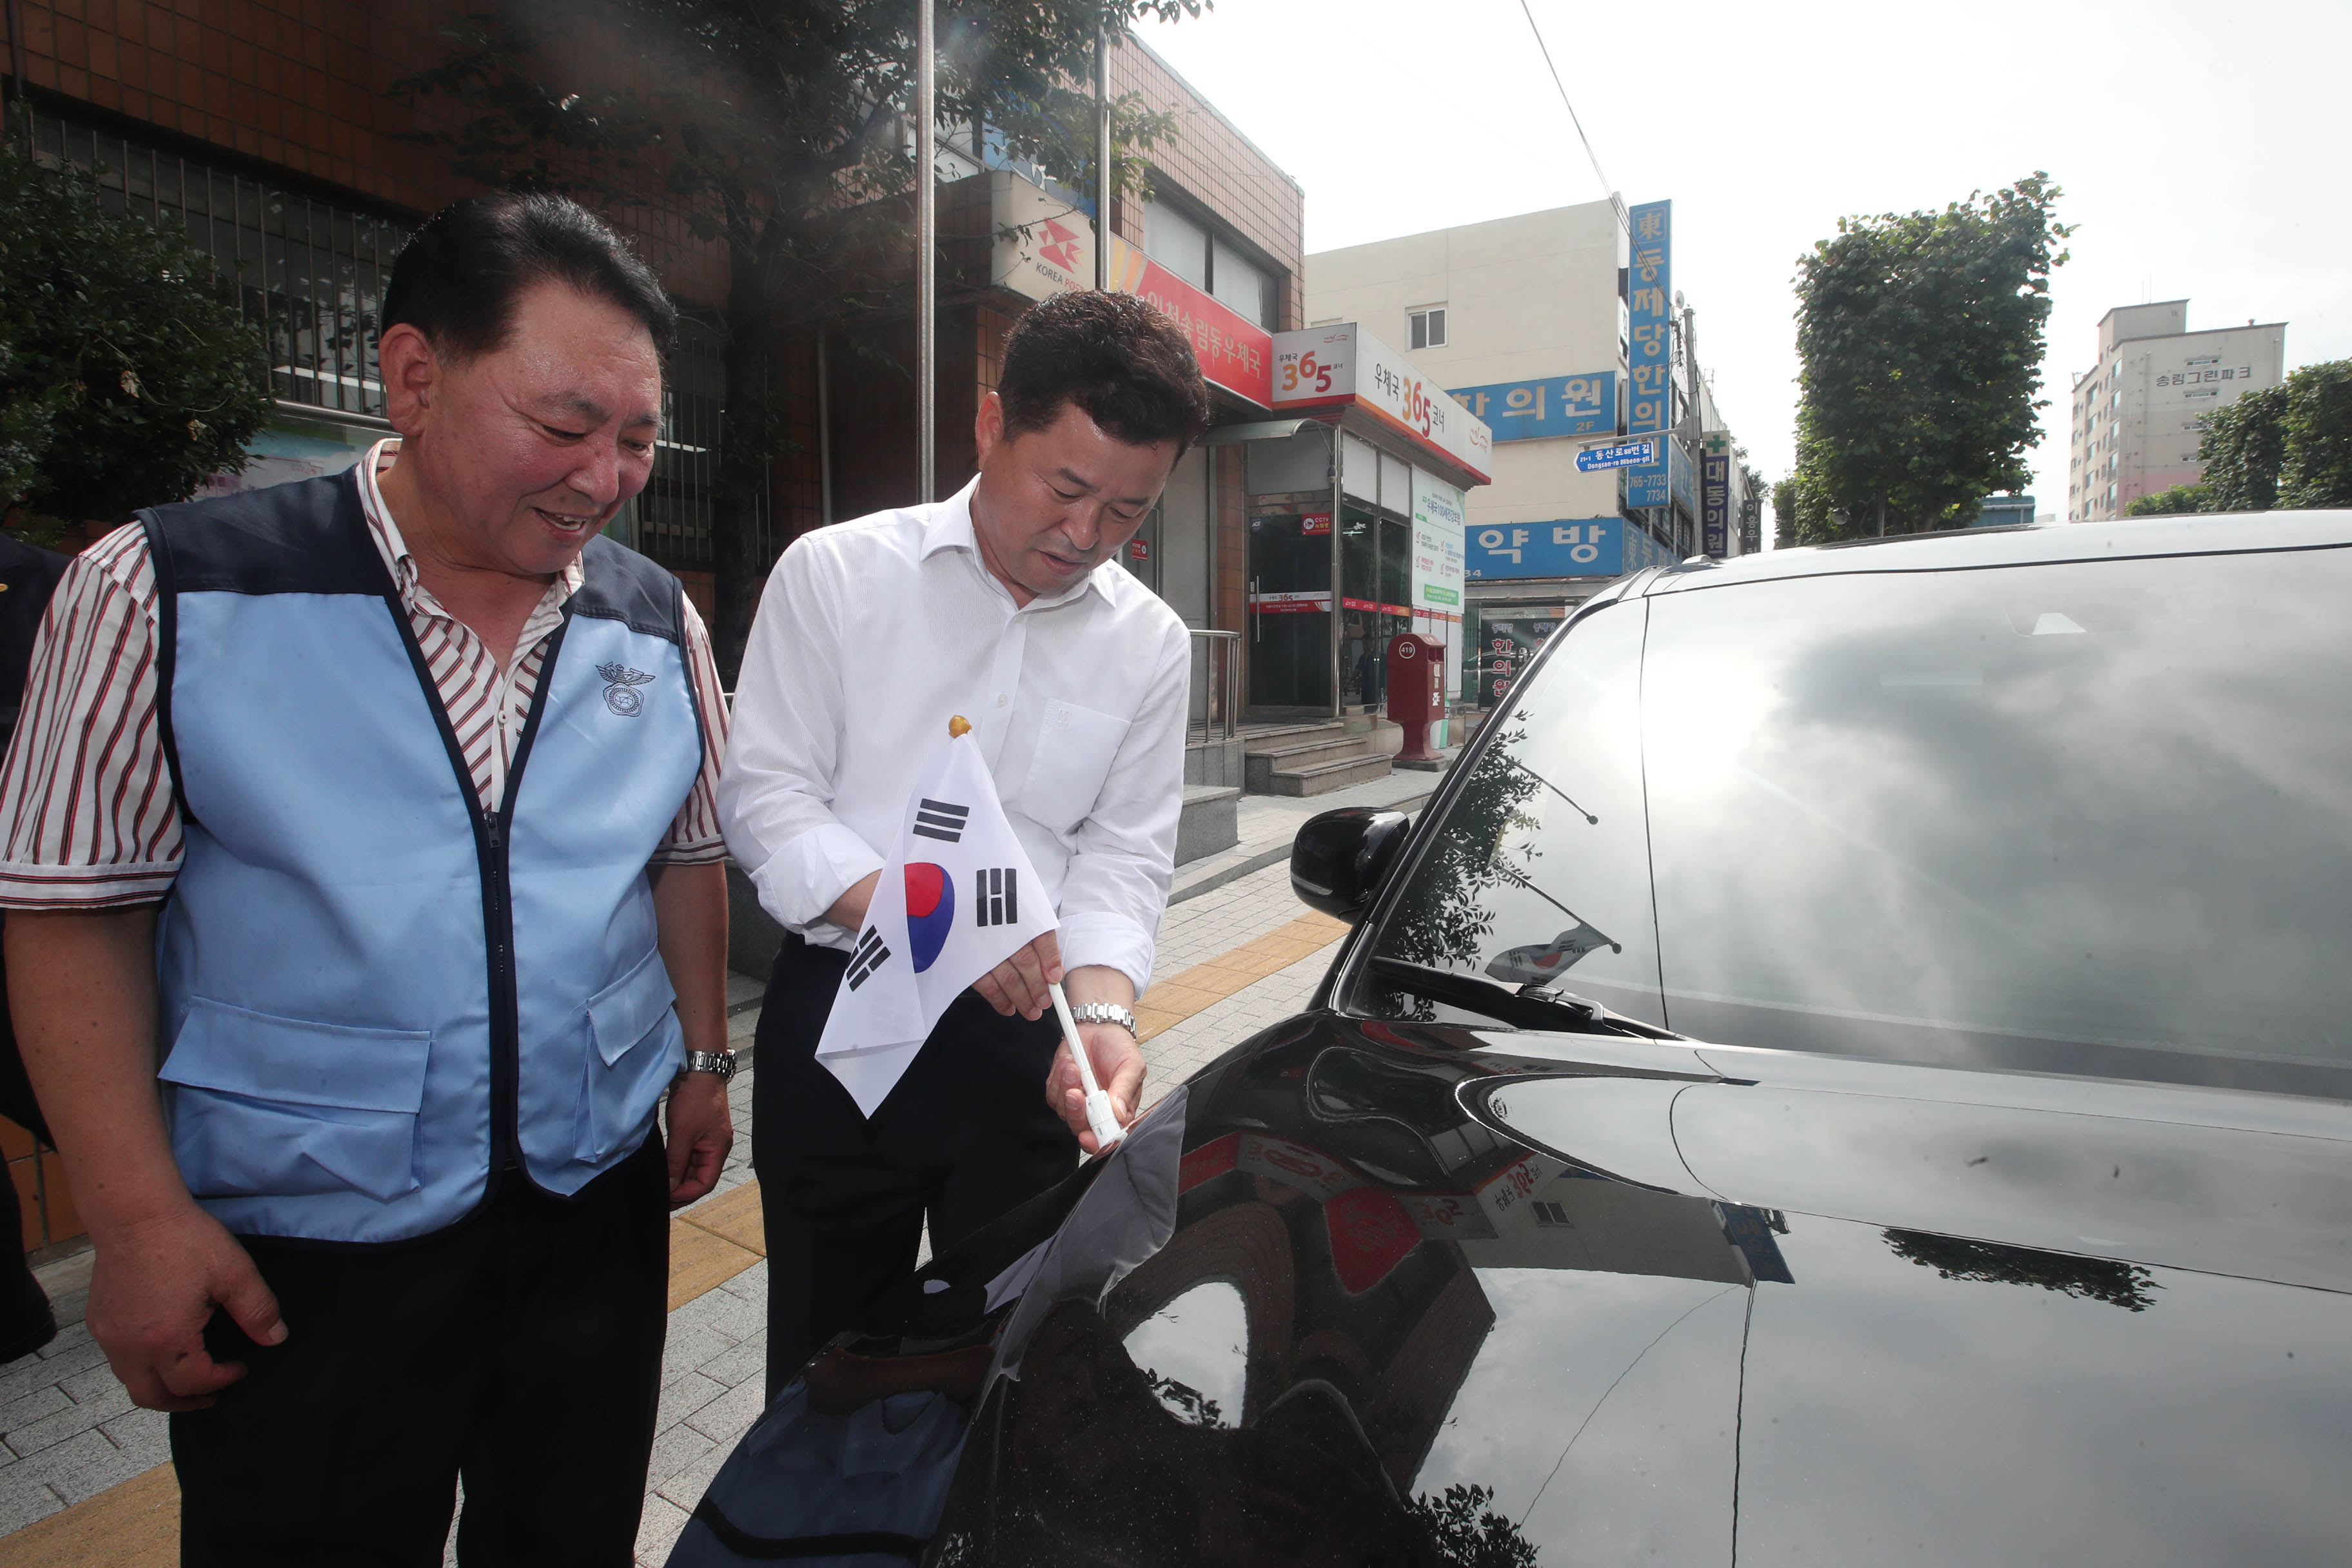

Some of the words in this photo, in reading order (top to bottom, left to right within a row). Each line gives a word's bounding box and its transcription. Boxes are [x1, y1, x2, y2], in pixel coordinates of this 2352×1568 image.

[1035, 262, 1063, 284] KOREA
[1279, 353, 1298, 362] 우체국
[1282, 350, 1332, 393] 365
[2156, 366, 2252, 387] 송림그린파크
[1375, 363, 1400, 402] 우체국
[1402, 376, 1431, 438] 365
[1433, 405, 1445, 434] 코너
[1575, 421, 1595, 431] 2F
[1587, 460, 1620, 470] Dongsan-ro
[1629, 474, 1667, 488] 765-7733
[1646, 489, 1667, 502] 7734
[1707, 461, 1726, 554] 대동의원
[1478, 525, 1606, 564] 약방
